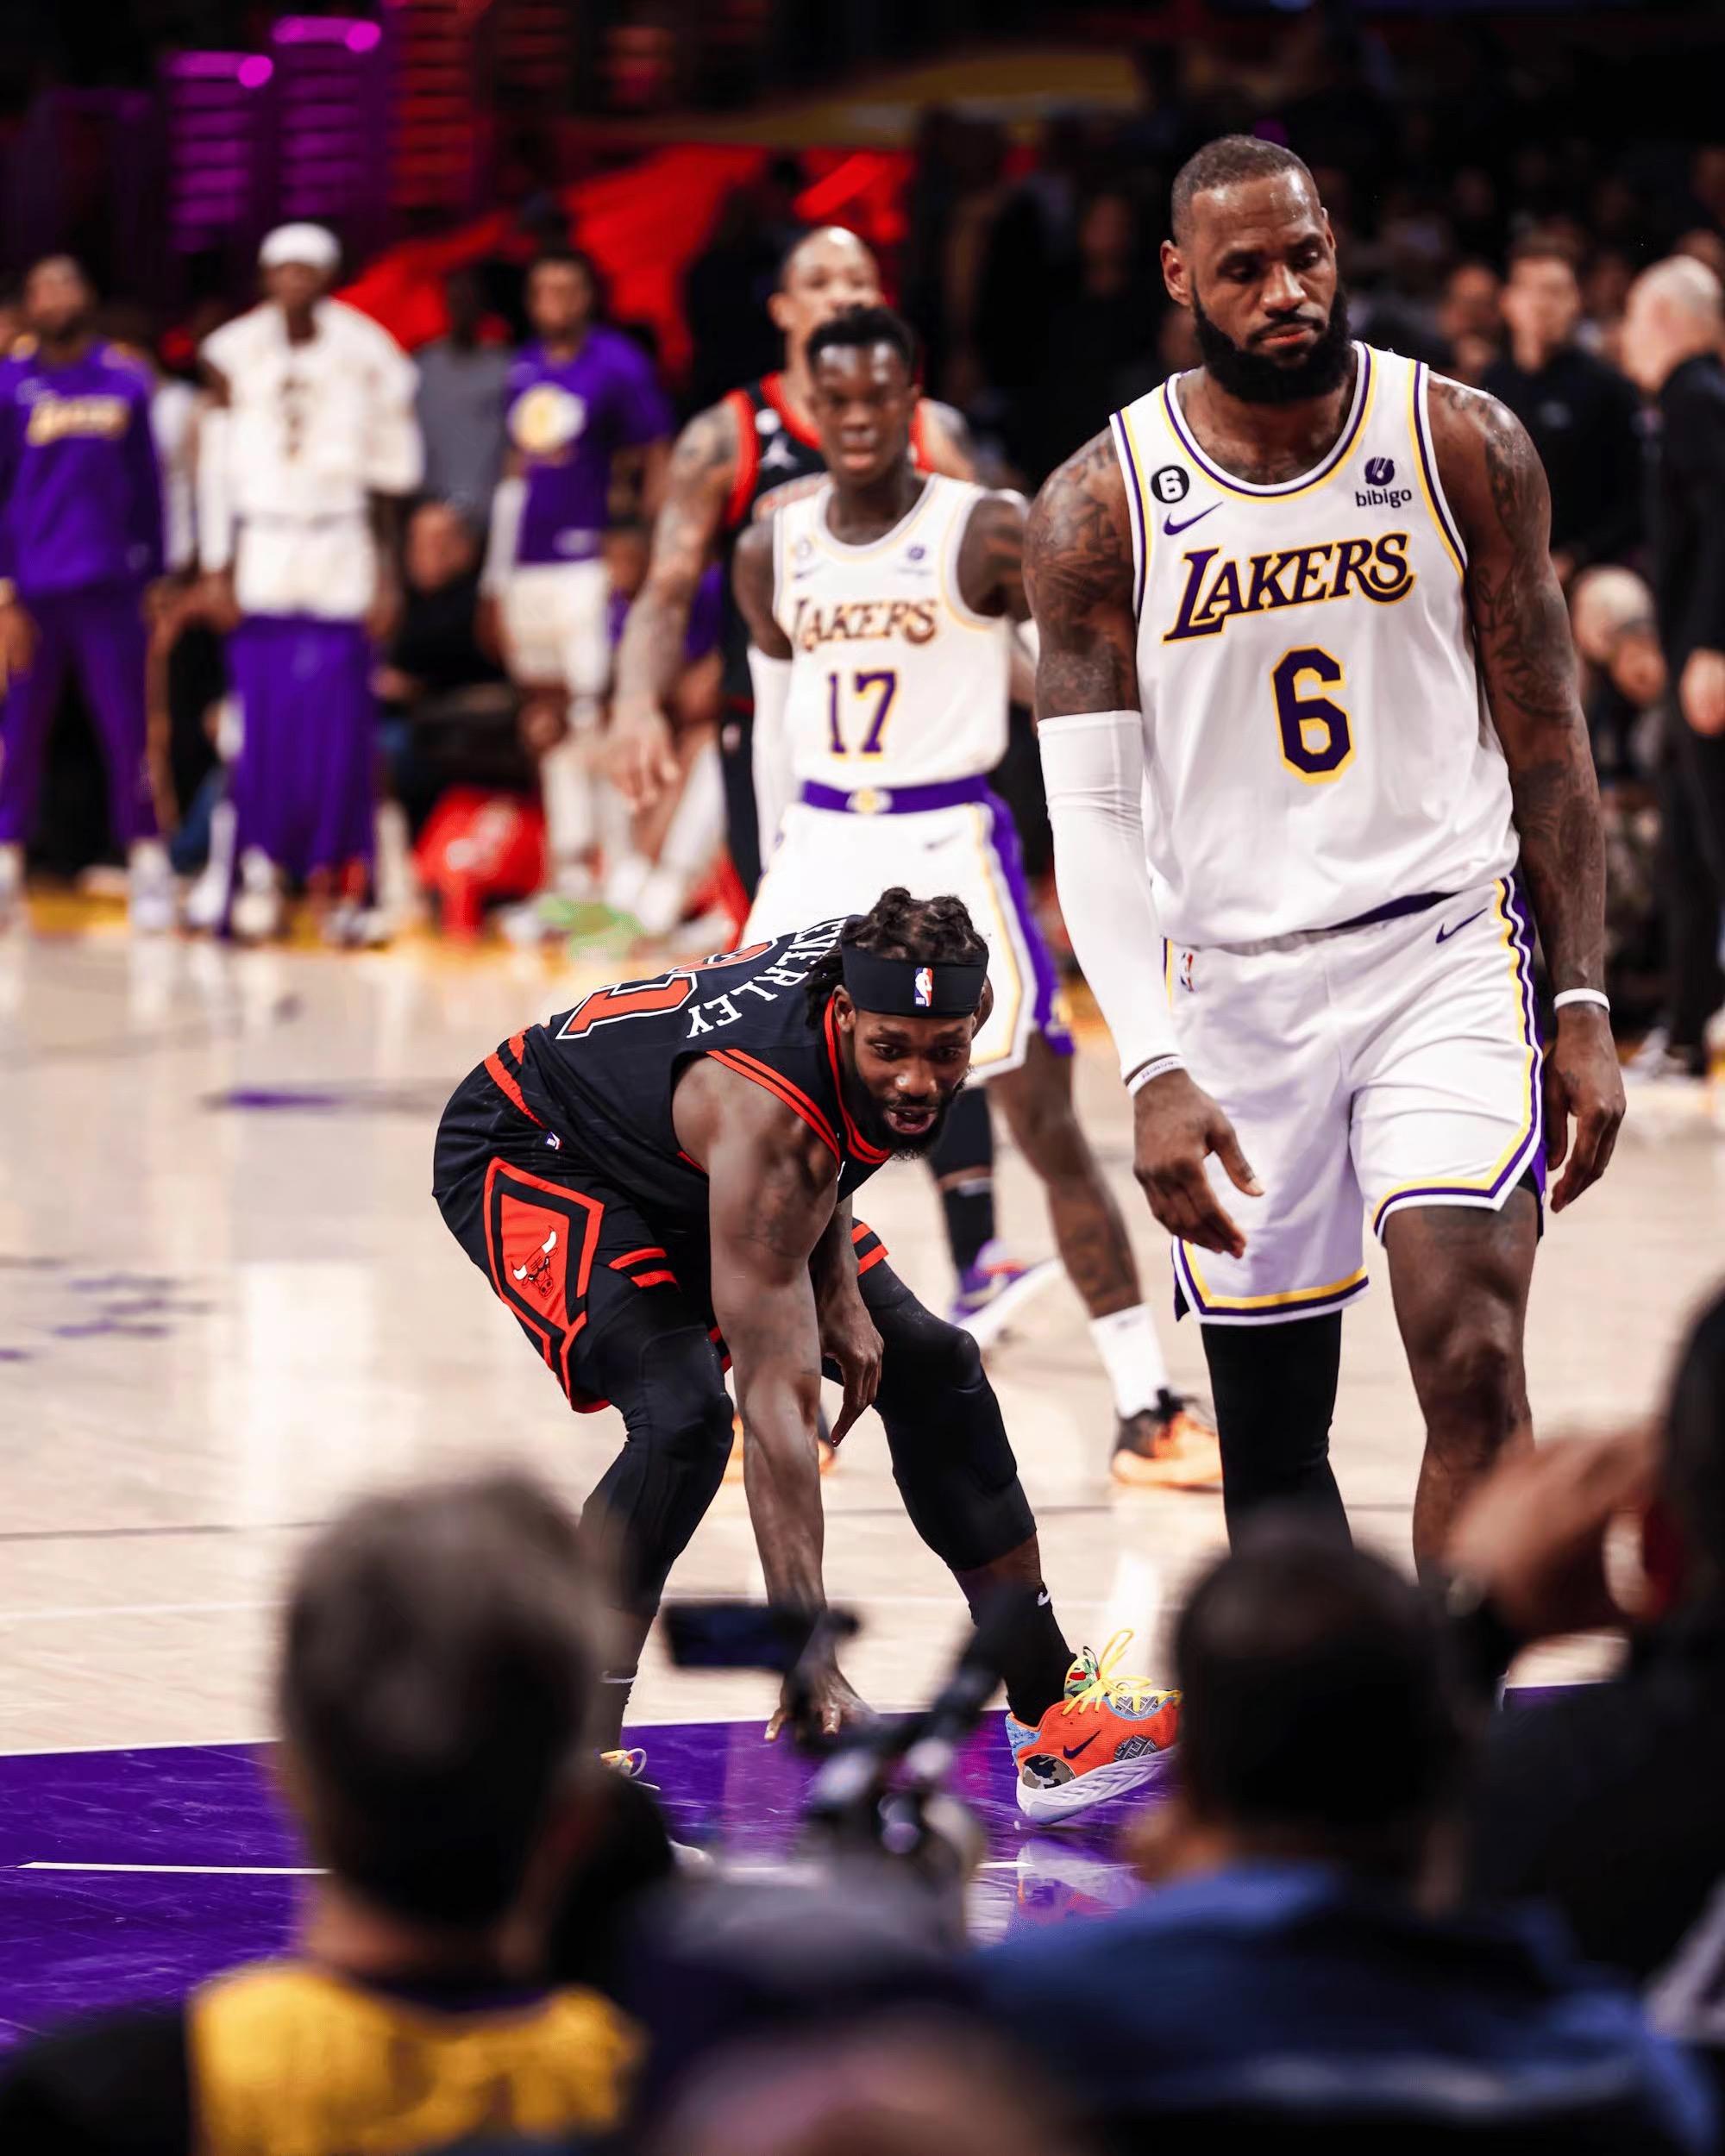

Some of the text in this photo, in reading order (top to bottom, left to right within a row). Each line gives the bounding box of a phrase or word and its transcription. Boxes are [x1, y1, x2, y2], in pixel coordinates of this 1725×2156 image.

[1158, 468, 1183, 500] 6
[1355, 486, 1413, 509] bibigo
[794, 598, 938, 653] LAKERS
[1161, 532, 1414, 646] LAKERS
[828, 668, 898, 762] 17
[1270, 644, 1357, 787] 6
